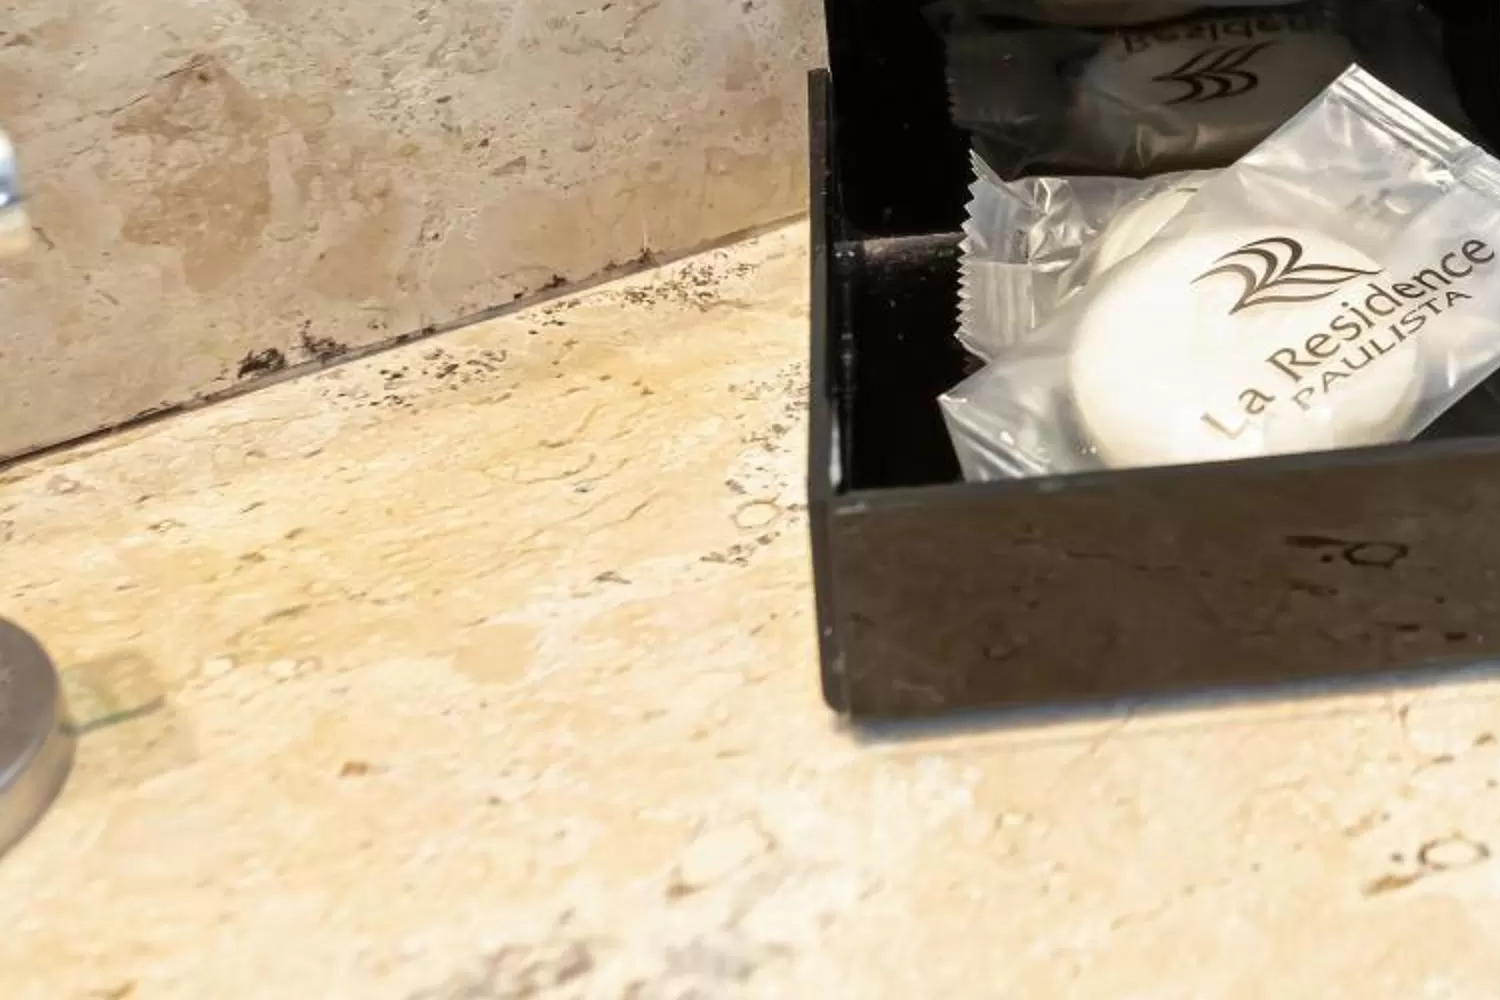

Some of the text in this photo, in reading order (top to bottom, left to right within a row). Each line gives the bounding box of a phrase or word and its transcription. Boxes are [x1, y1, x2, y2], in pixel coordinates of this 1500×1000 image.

[1200, 238, 1496, 441] La Residence
[1291, 289, 1473, 411] PAULISTA
